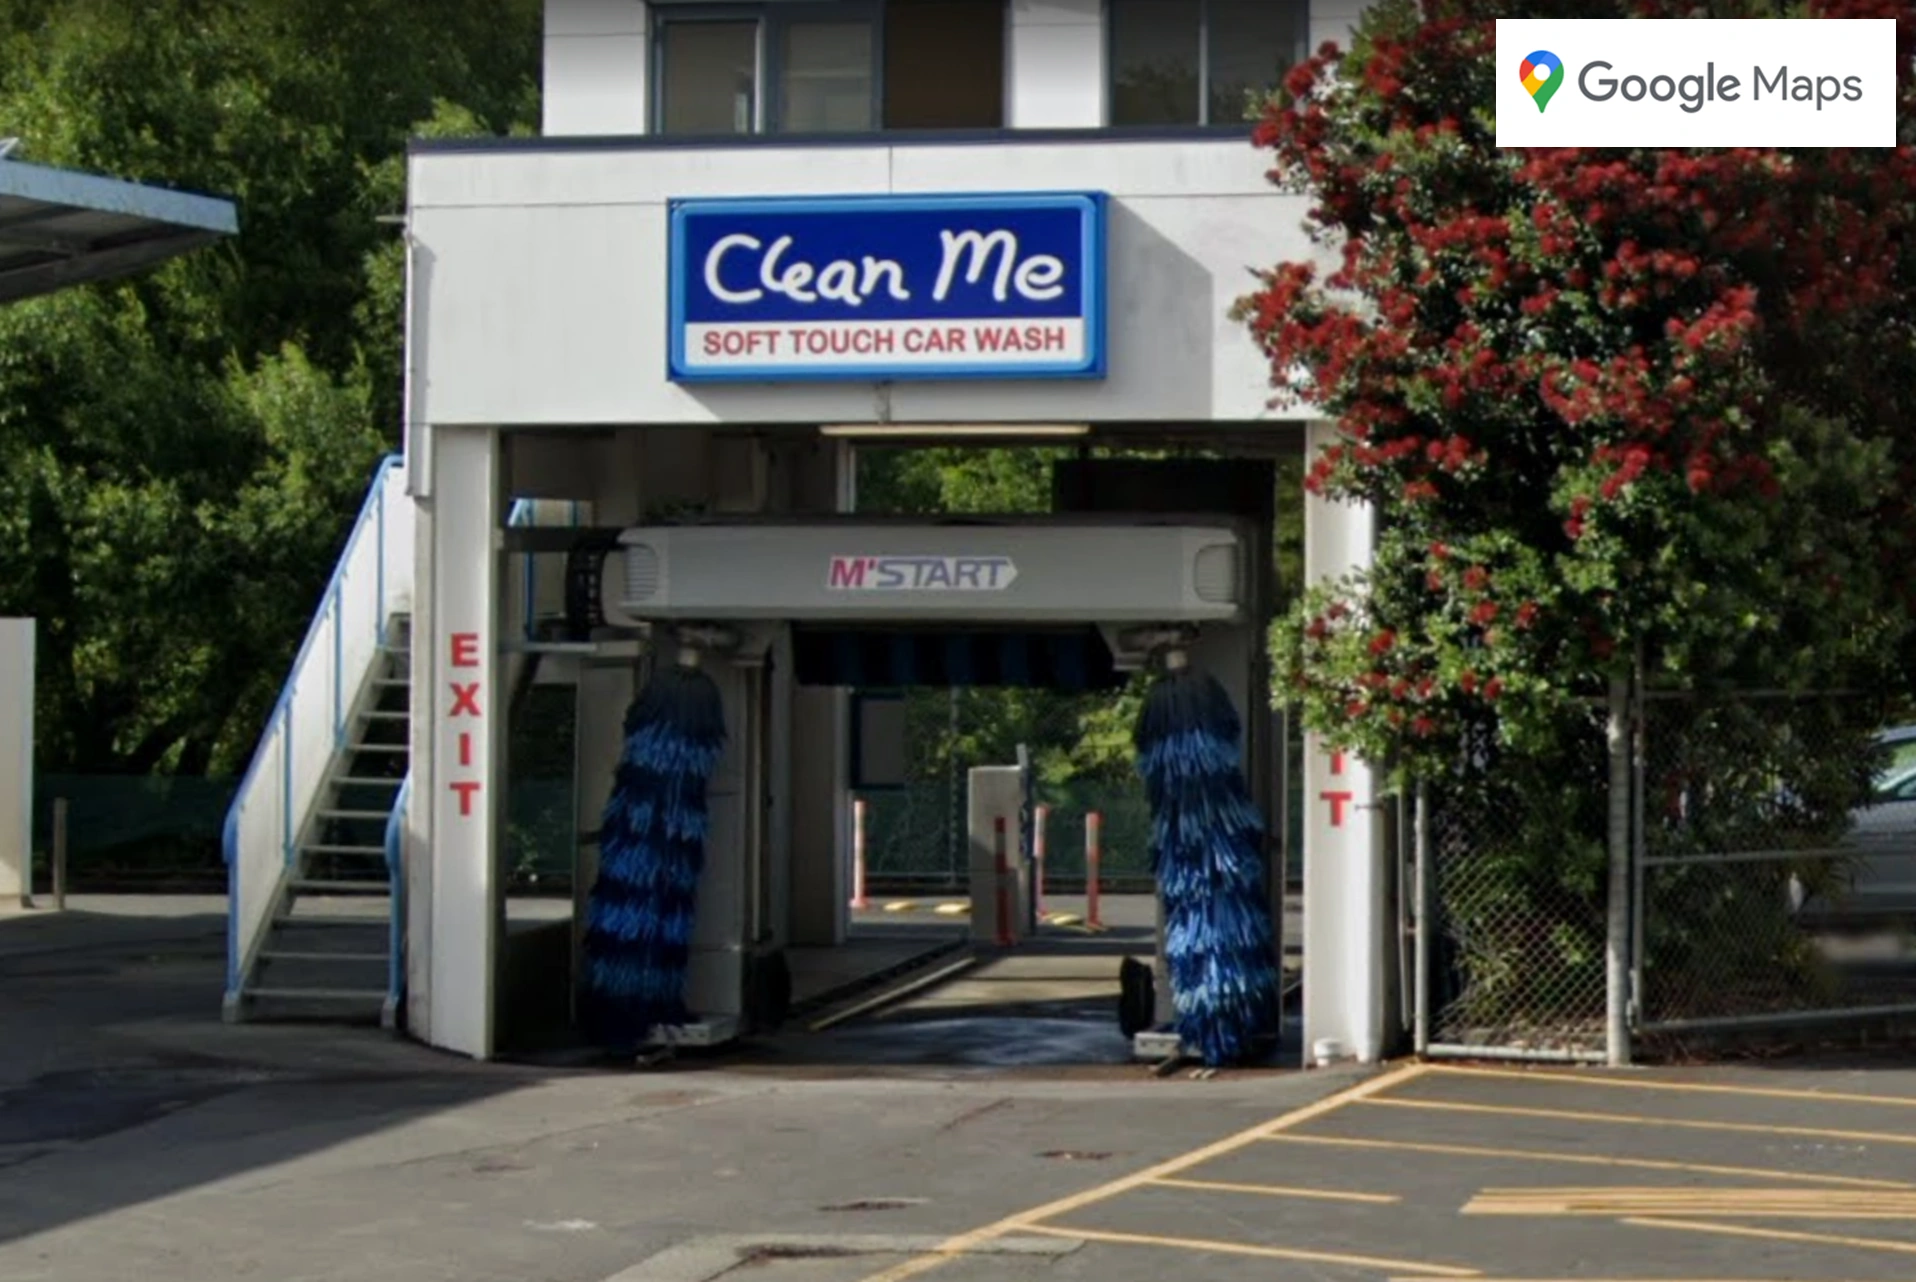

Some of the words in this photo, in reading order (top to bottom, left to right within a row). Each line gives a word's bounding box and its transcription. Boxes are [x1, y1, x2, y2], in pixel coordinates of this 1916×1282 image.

[704, 233, 910, 306] Clean
[932, 229, 1064, 301] Me
[703, 330, 781, 355] SOFT
[788, 329, 894, 354] TOUCH
[902, 328, 966, 353] CAR
[974, 326, 1065, 352] WASH
[830, 558, 1007, 588] M'START
[449, 632, 481, 817] EXIT
